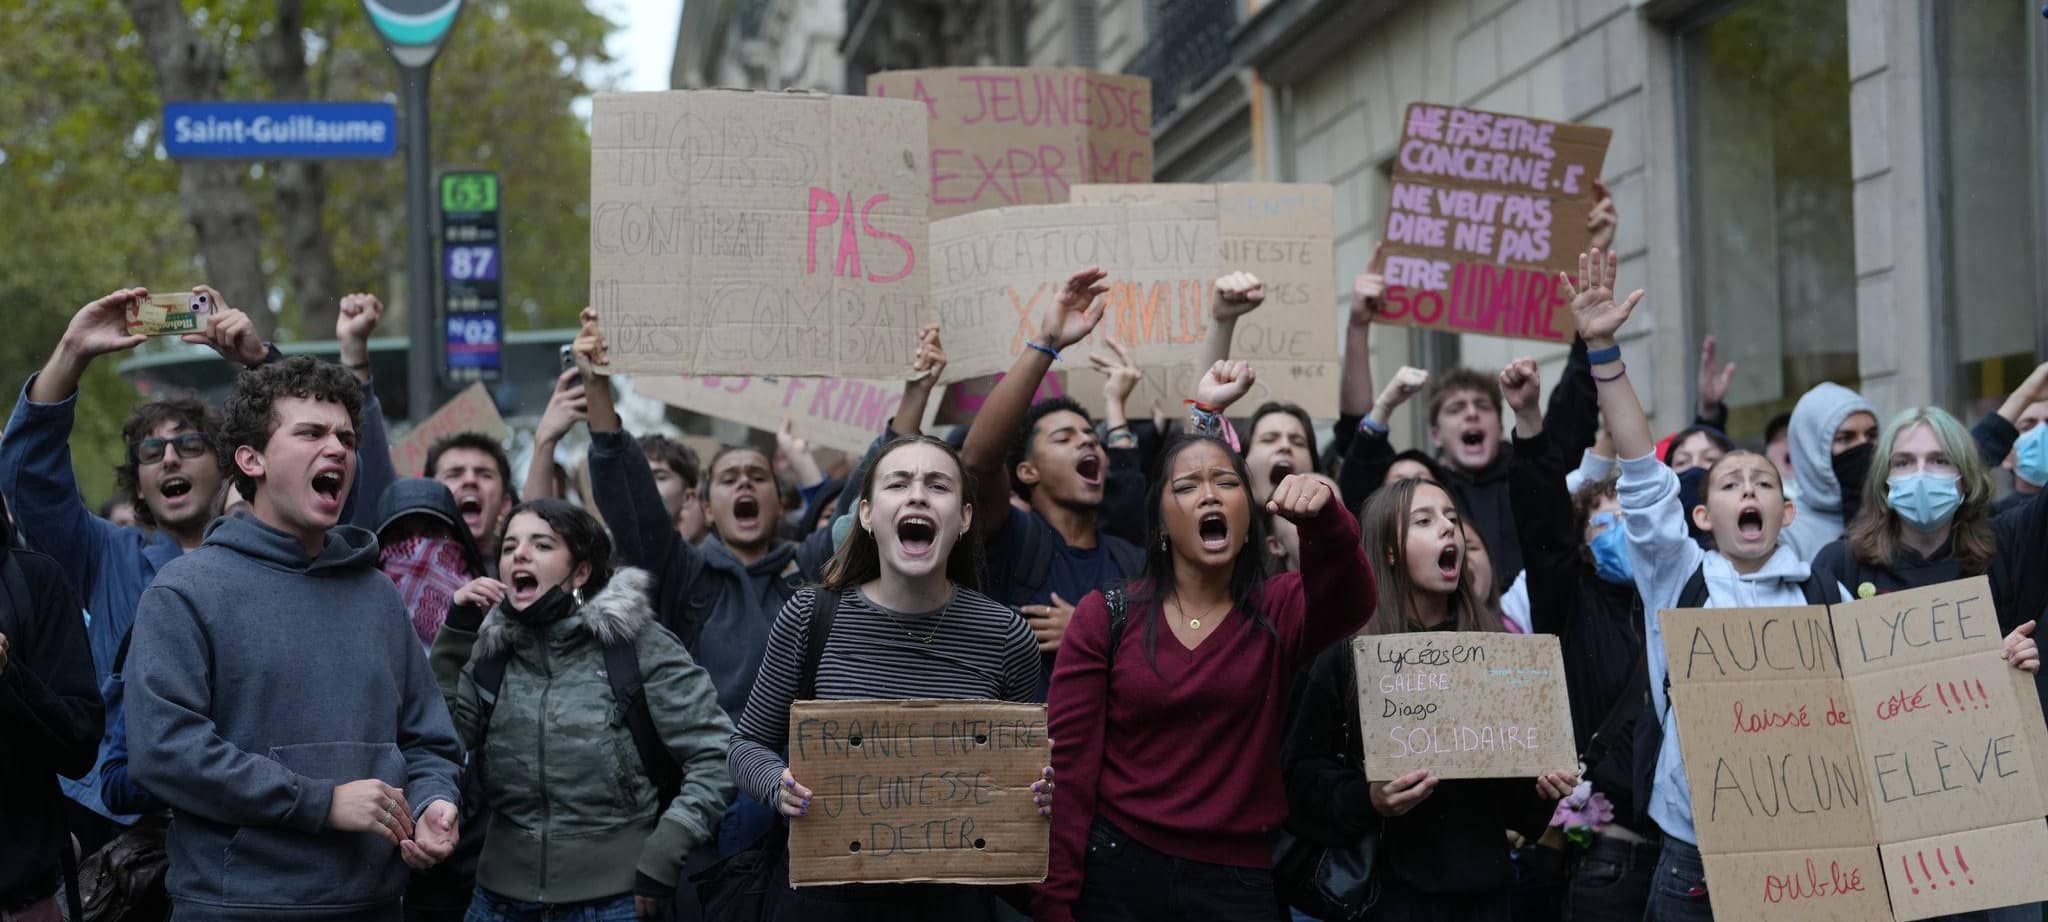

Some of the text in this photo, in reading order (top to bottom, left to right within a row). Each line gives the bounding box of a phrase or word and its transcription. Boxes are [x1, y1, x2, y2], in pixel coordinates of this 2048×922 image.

[958, 74, 1151, 136] JEUNESSE
[1407, 104, 1446, 141] NE
[1446, 109, 1495, 147] PAS
[174, 115, 386, 144] Saint-Guillaume
[618, 112, 818, 188] HORS
[1392, 182, 1552, 230] NE VEUT PAS
[592, 187, 915, 284] CONTRAT PAS
[1148, 222, 1201, 265] UN
[1387, 212, 1552, 266] DIRE NE PAS
[450, 246, 494, 280] 87
[1384, 255, 1451, 291] ETRE
[704, 280, 927, 366] COMBAT
[1237, 323, 1313, 358] QUE
[1687, 597, 1986, 680] AUCUN LYCÉE
[1379, 671, 1450, 694] GALÈRE
[1382, 698, 1438, 721] Diago
[1733, 701, 1811, 734] laissé
[1826, 698, 1850, 727] de
[1876, 684, 1931, 720] côté
[797, 719, 920, 761] FRANCE
[1390, 726, 1539, 759] SOLIDAIRE
[823, 771, 993, 819] JEUNESSE
[1711, 734, 2019, 822] AUCUN ELÈVE
[869, 816, 978, 858] DETER
[1764, 857, 1866, 904] oublié
